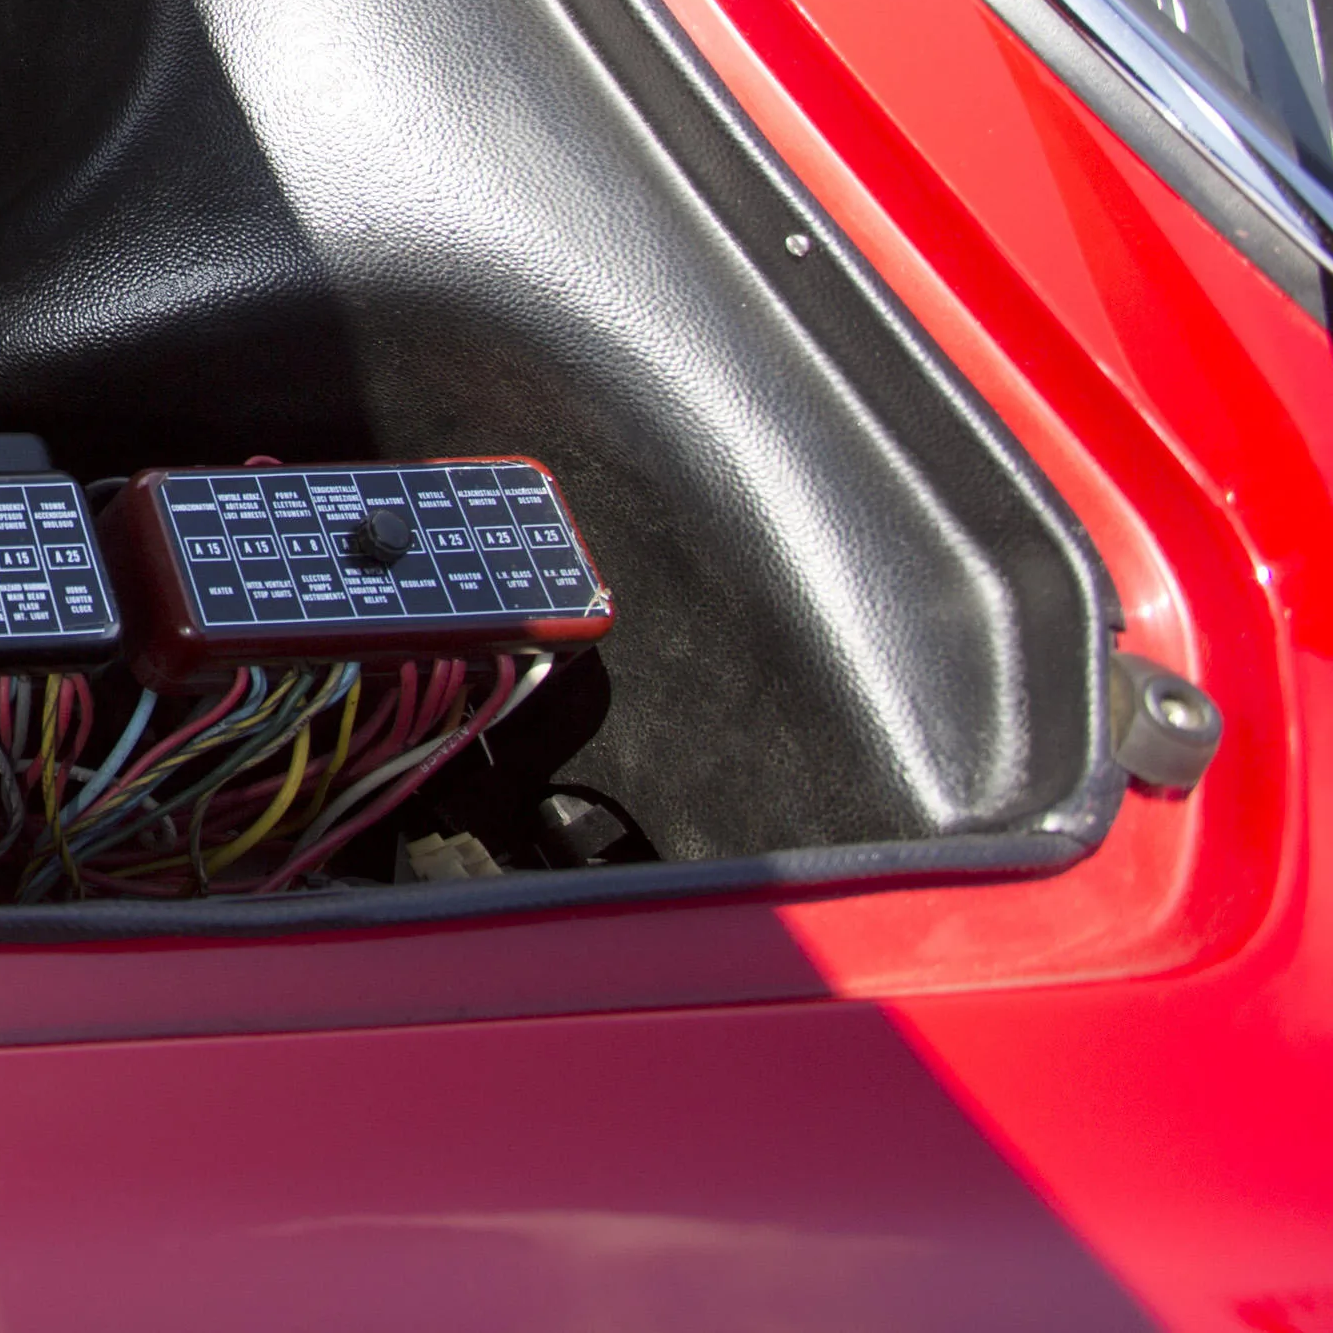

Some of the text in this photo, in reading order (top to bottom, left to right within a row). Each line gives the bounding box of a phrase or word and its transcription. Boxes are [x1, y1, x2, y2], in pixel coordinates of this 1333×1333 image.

[418, 491, 445, 499] VENTOLE
[366, 497, 404, 505] REGOLATORE
[418, 500, 452, 508] RADIATORE
[468, 498, 497, 506] SINISTRO
[518, 496, 542, 504] DESTRO
[40, 502, 66, 510] TROMBE
[273, 501, 307, 509] ELETTRICA
[317, 503, 362, 512] RELAY VENTOLE
[223, 512, 238, 520] LUCI
[275, 510, 311, 518] STRUMENTI
[326, 512, 360, 520] RADIATORE
[511, 570, 532, 578] GLASS
[560, 568, 581, 576] GLASS
[301, 574, 332, 582] ELECTRIC
[343, 577, 361, 585] TURN
[361, 577, 384, 585] SIGNAL
[449, 573, 482, 581] RADIATOR
[400, 579, 436, 588] REGULATOR
[507, 580, 529, 588] LIFTER
[556, 577, 577, 586] LIFTER
[65, 586, 87, 594] HORNS
[209, 587, 233, 595] HEATER
[309, 583, 331, 591] PUMPS
[349, 586, 377, 594] RADIATOR
[7, 592, 46, 601] MAIN BEAM
[253, 590, 292, 599] STOP LIGHTS
[302, 592, 346, 601] INSTRUMENTS
[65, 595, 93, 604] LIGHTER
[364, 596, 388, 604] RELAYS
[18, 602, 40, 611] FLASH
[71, 605, 93, 613] CLOCK
[30, 611, 49, 620] LIGHT
